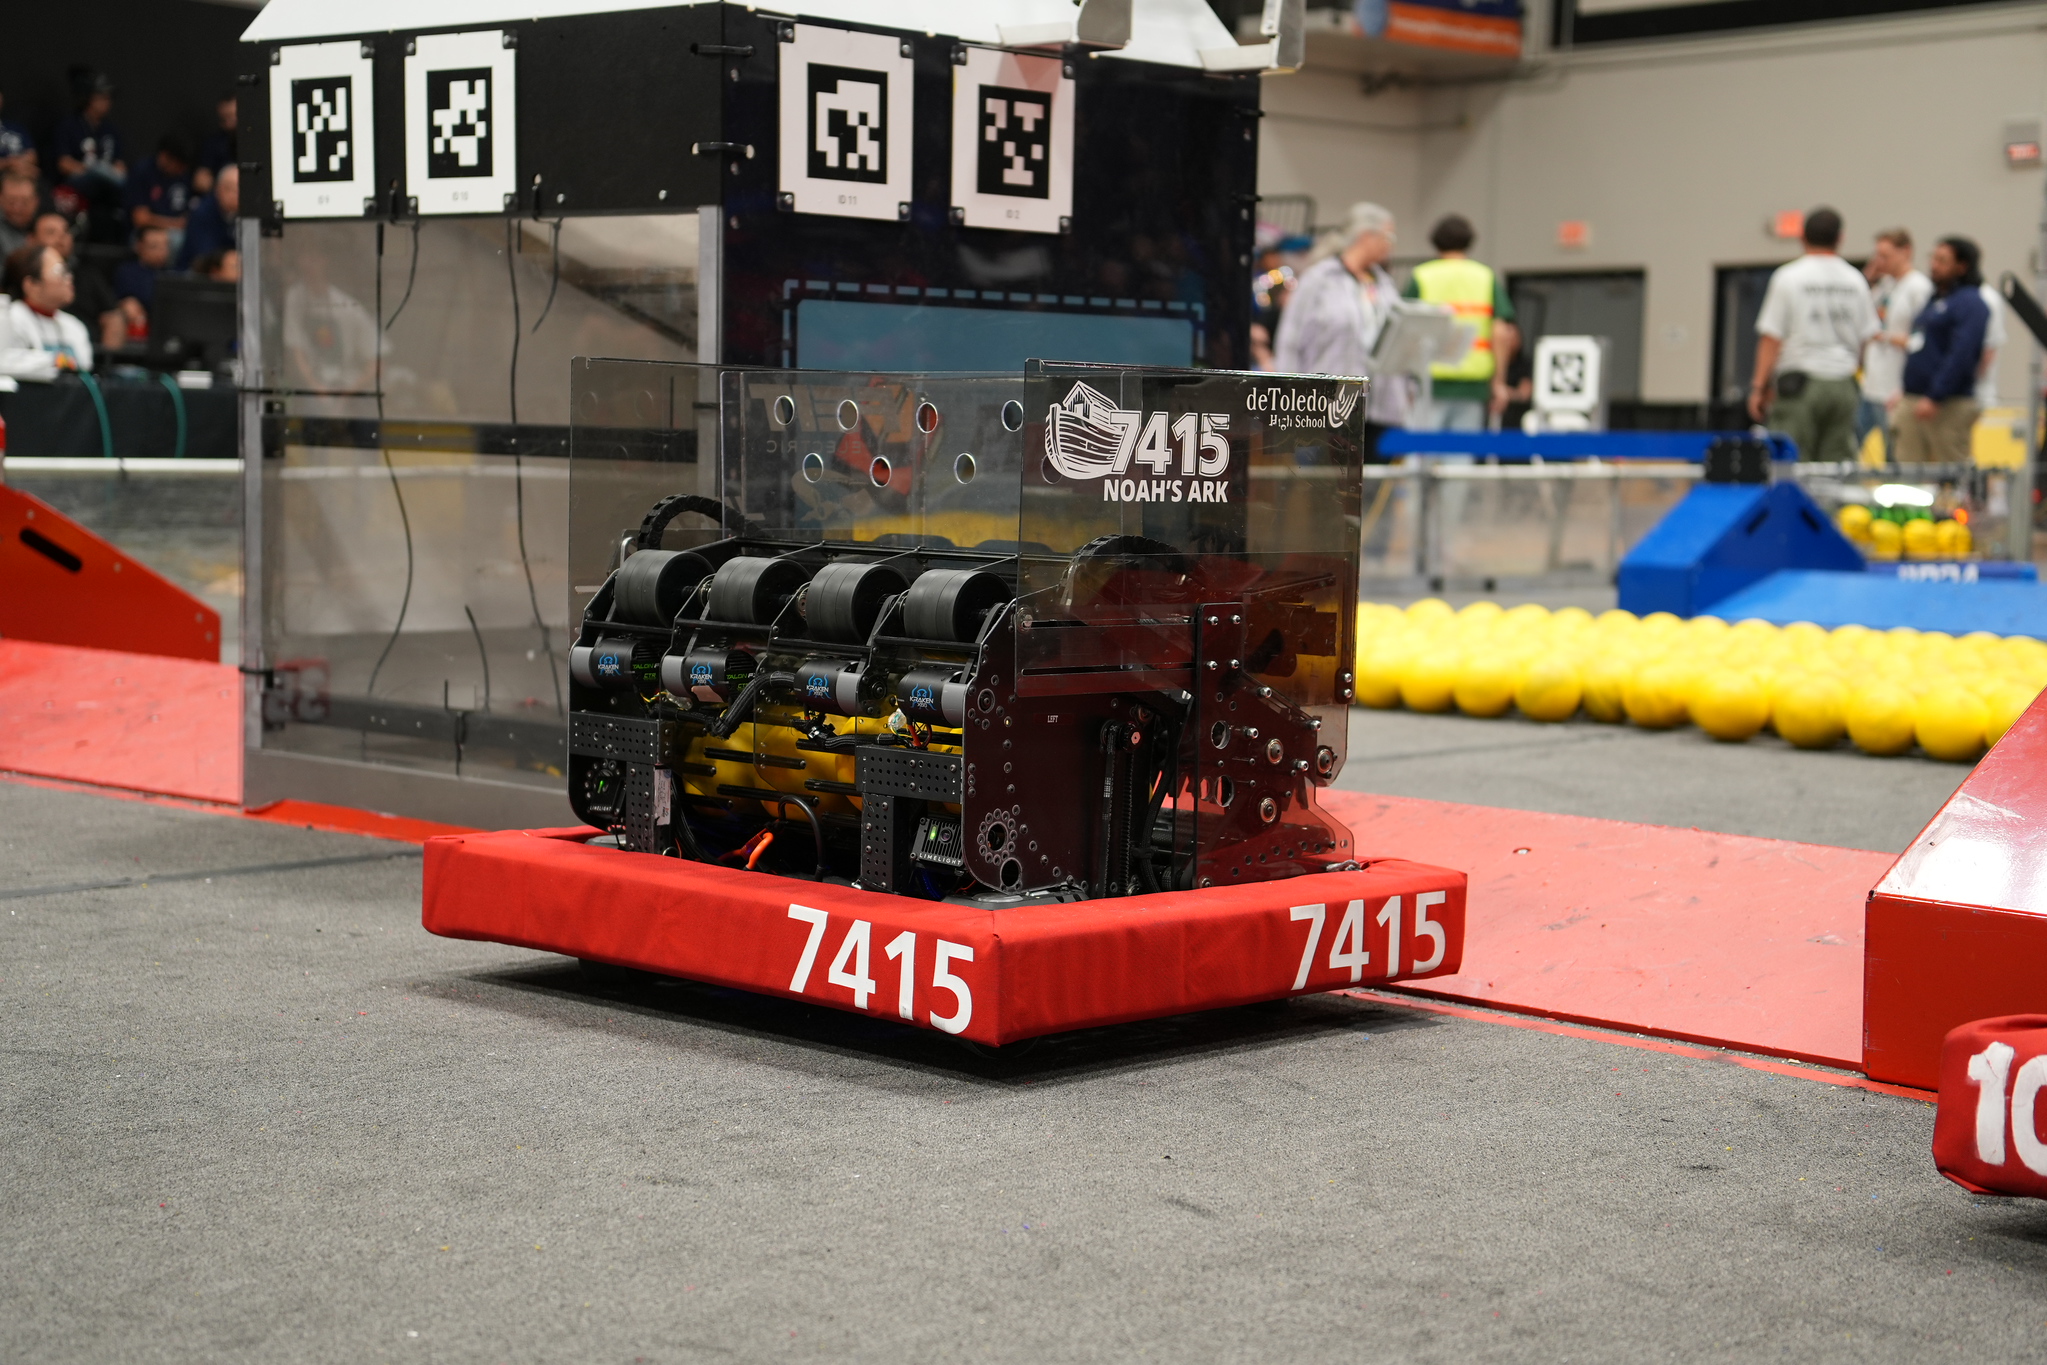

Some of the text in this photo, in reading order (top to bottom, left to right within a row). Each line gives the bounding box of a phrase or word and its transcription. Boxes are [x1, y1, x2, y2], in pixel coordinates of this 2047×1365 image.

[838, 194, 857, 205] ID 11
[1246, 387, 1327, 412] deToledo
[1295, 414, 1326, 429] School
[1109, 410, 1230, 478] 7415
[1103, 479, 1229, 503] NOAH'S ARK
[806, 685, 829, 693] KRAKEN
[909, 695, 934, 704] KRAKEN
[1047, 715, 1059, 723] LEFT
[919, 853, 962, 866] LIMELIGHT
[1289, 890, 1447, 991] 7415
[786, 903, 976, 1035] 7415
